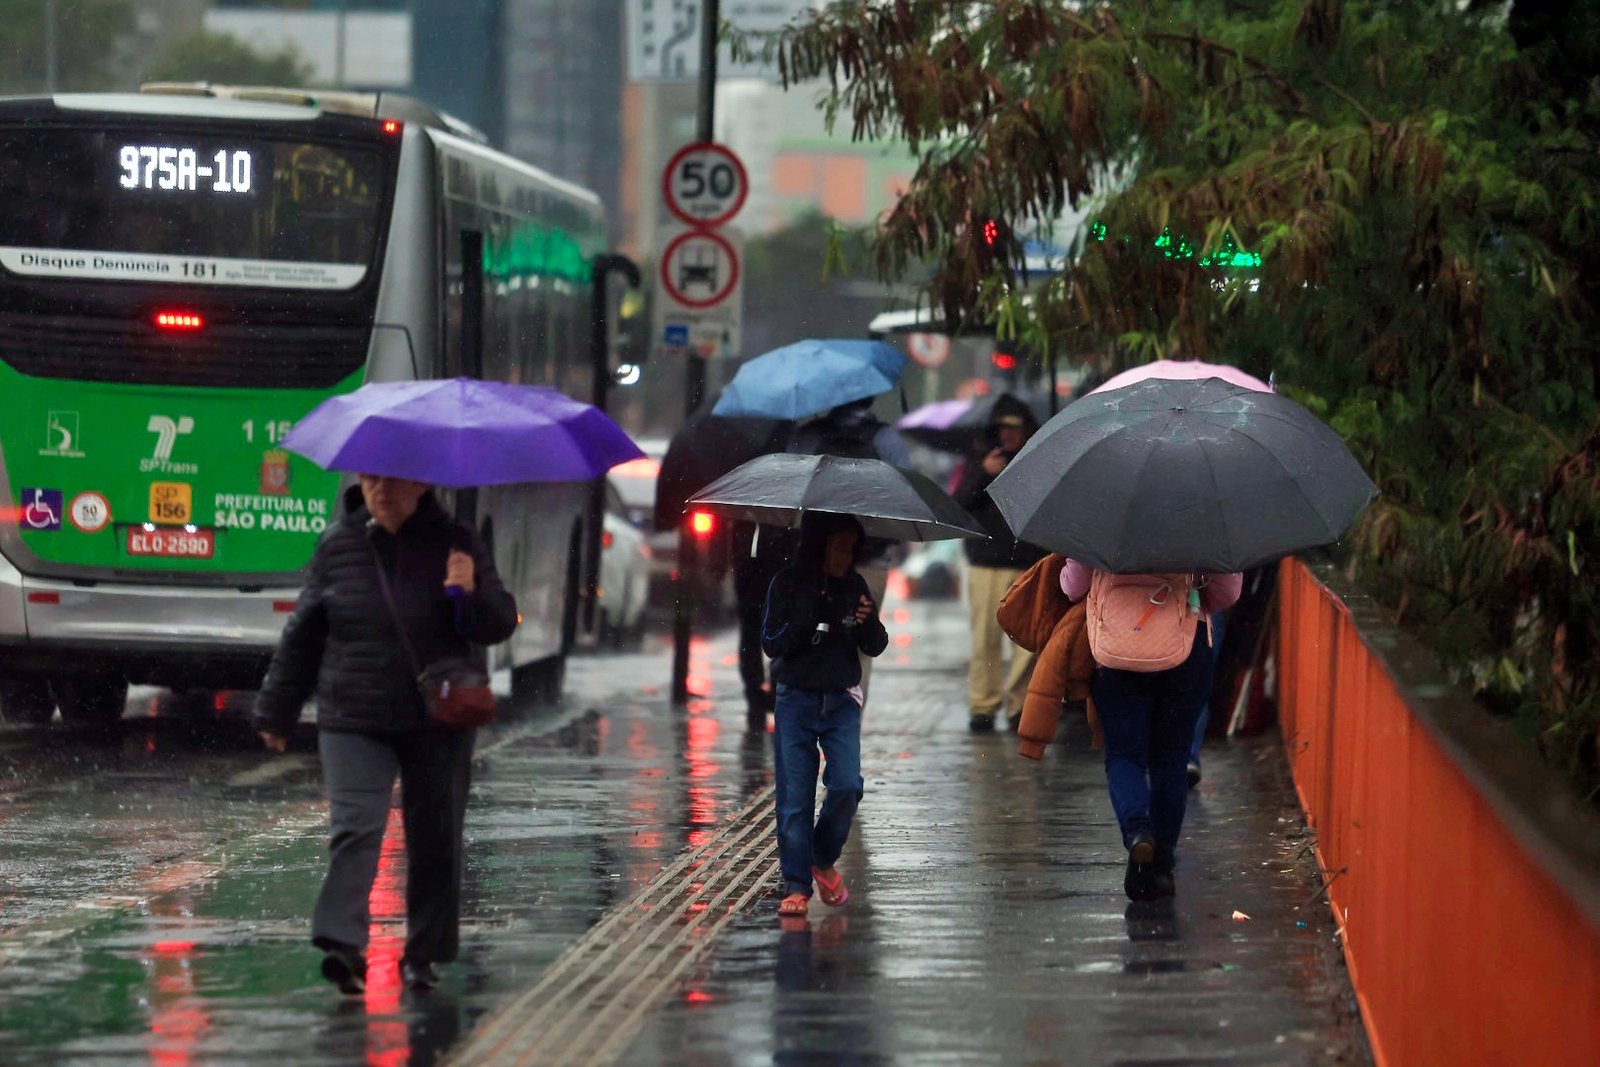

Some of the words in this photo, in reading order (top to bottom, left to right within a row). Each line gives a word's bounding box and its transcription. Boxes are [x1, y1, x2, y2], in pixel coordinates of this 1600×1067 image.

[120, 146, 251, 193] 975A-10
[681, 161, 735, 200] 50
[20, 253, 86, 269] Disque
[92, 257, 170, 273] Denúncia
[181, 261, 217, 277] 181
[156, 487, 178, 499] SP
[215, 493, 304, 513] PREFEITURA
[307, 498, 326, 514] DE
[82, 504, 98, 515] 50
[155, 502, 186, 519] 156
[214, 509, 256, 529] SÃO
[260, 512, 327, 533] PAULO
